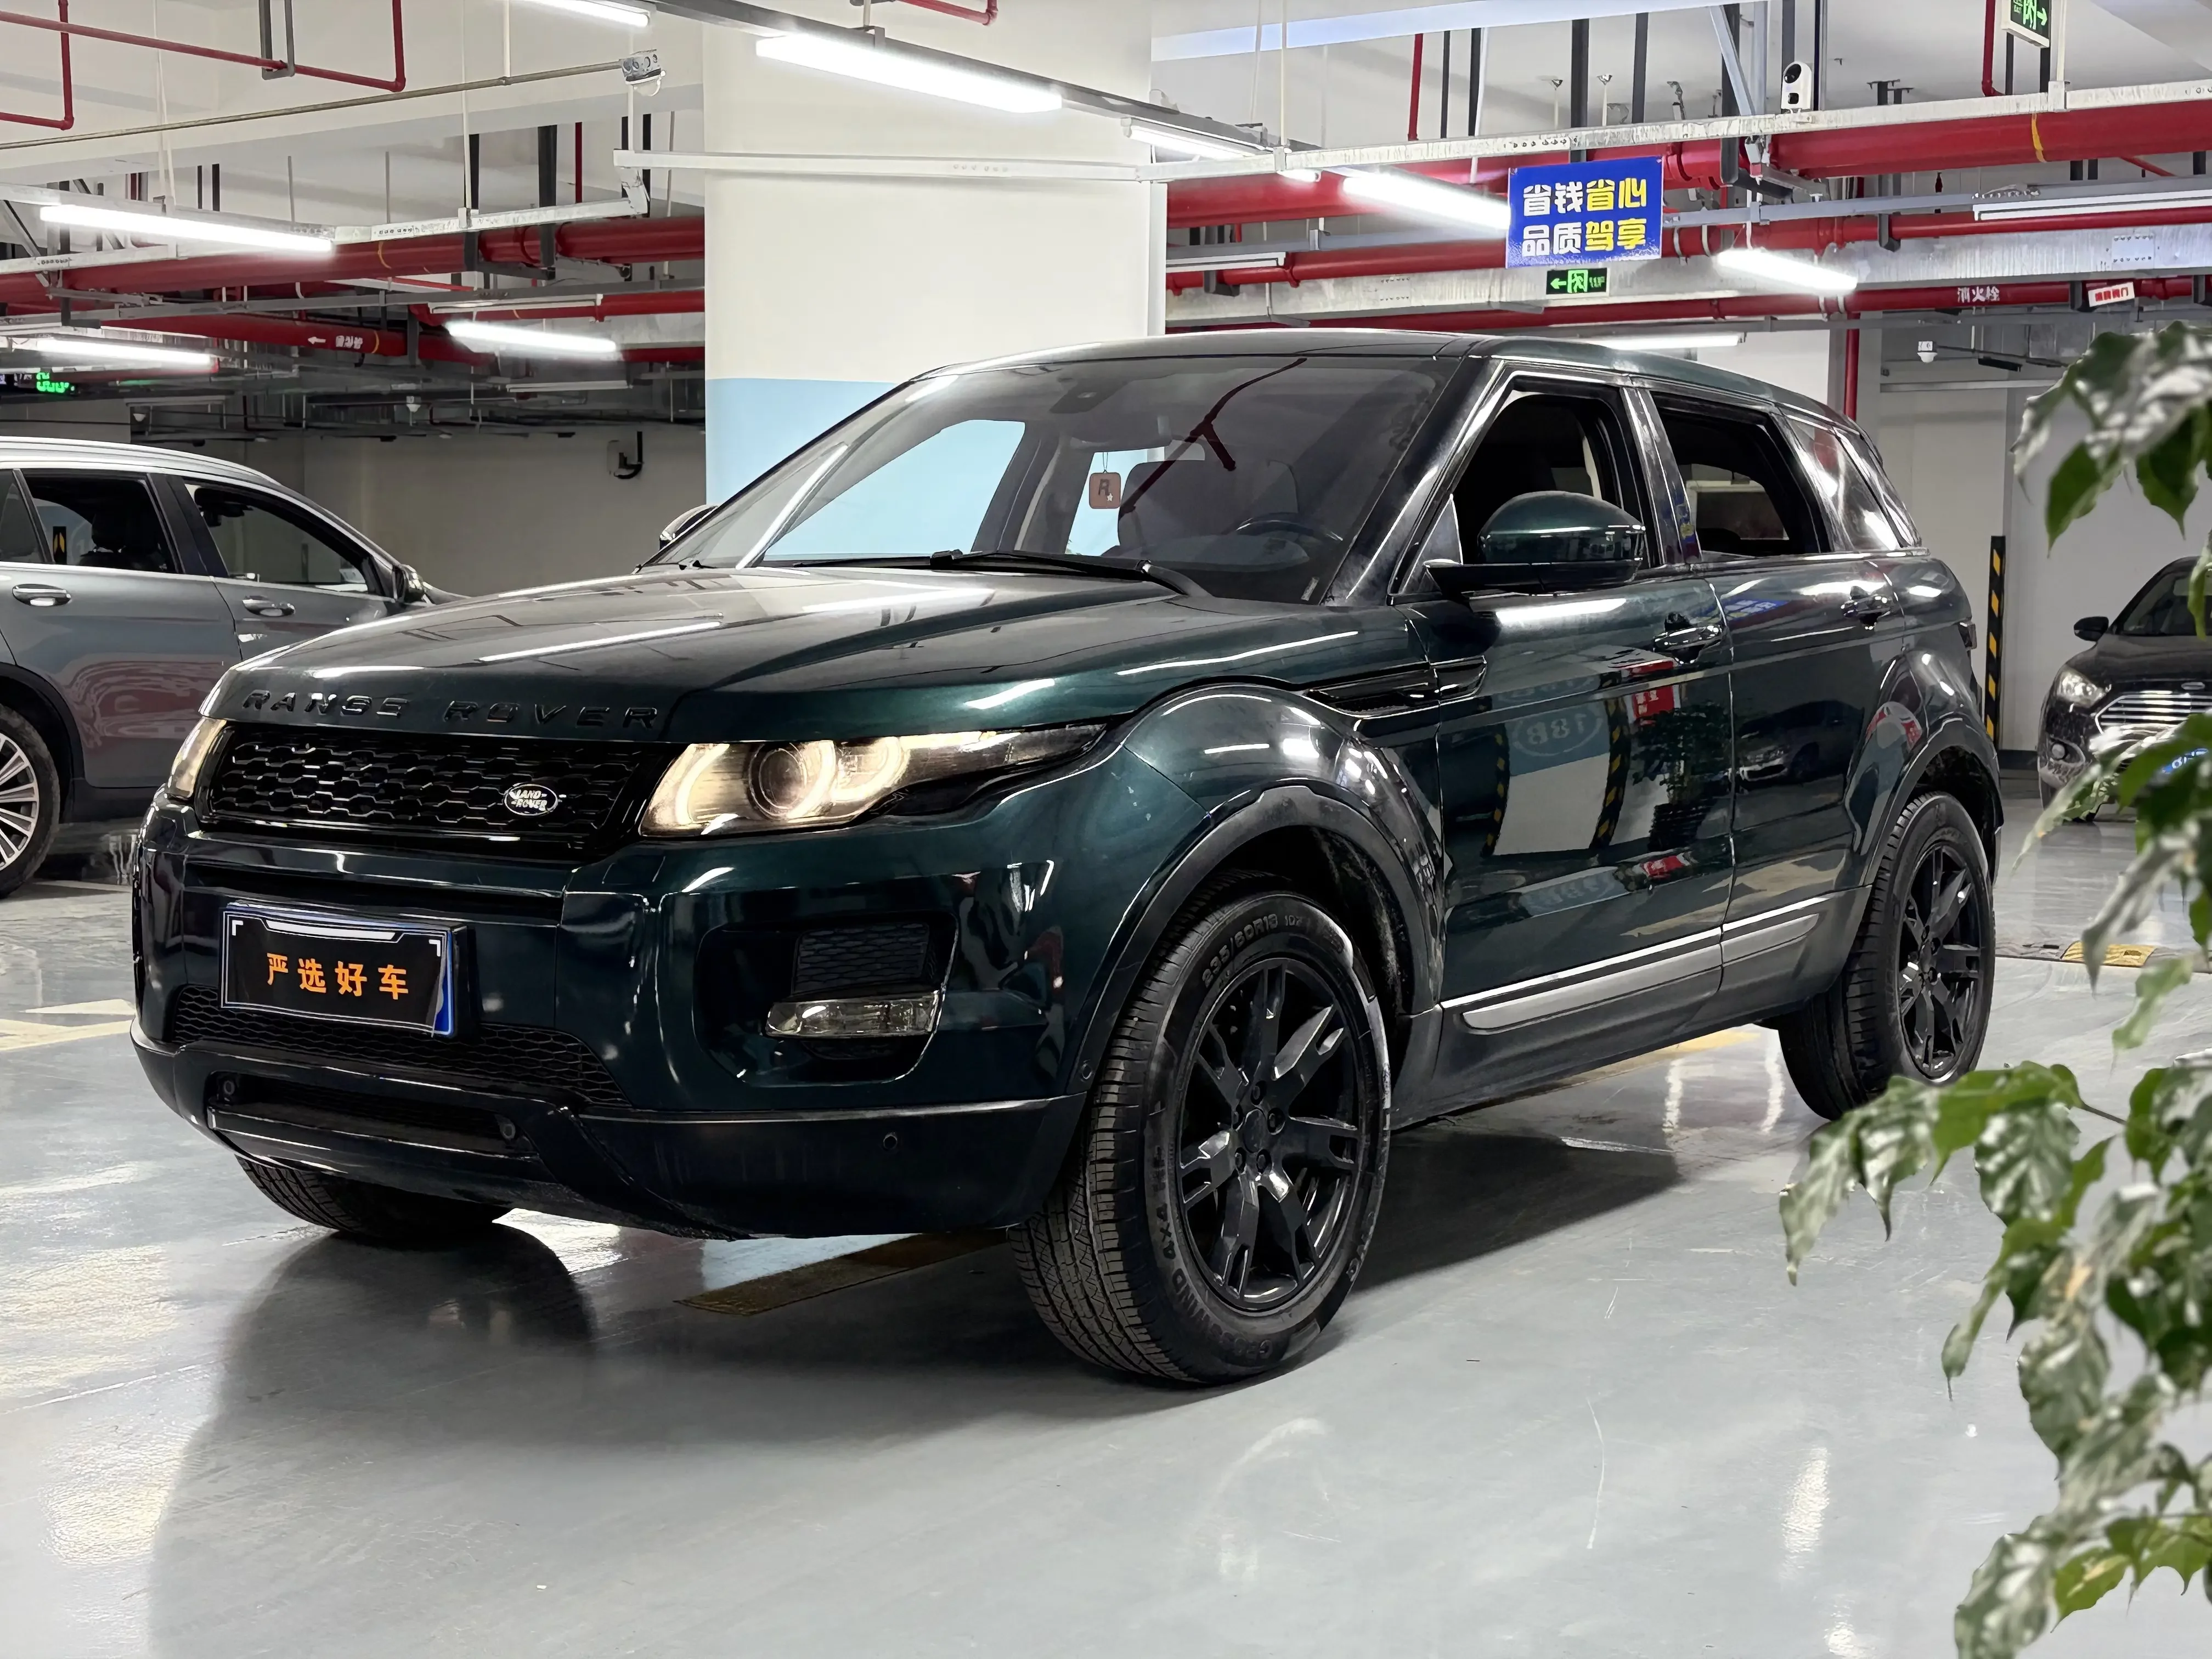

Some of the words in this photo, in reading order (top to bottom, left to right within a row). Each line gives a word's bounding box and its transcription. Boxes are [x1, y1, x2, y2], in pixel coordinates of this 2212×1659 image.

[1523, 178, 1646, 216] 省钱省心
[1522, 218, 1646, 257] 品质驾享
[242, 689, 410, 719] RANGE
[443, 701, 658, 729] ROVER
[267, 952, 409, 1000] 严选好车
